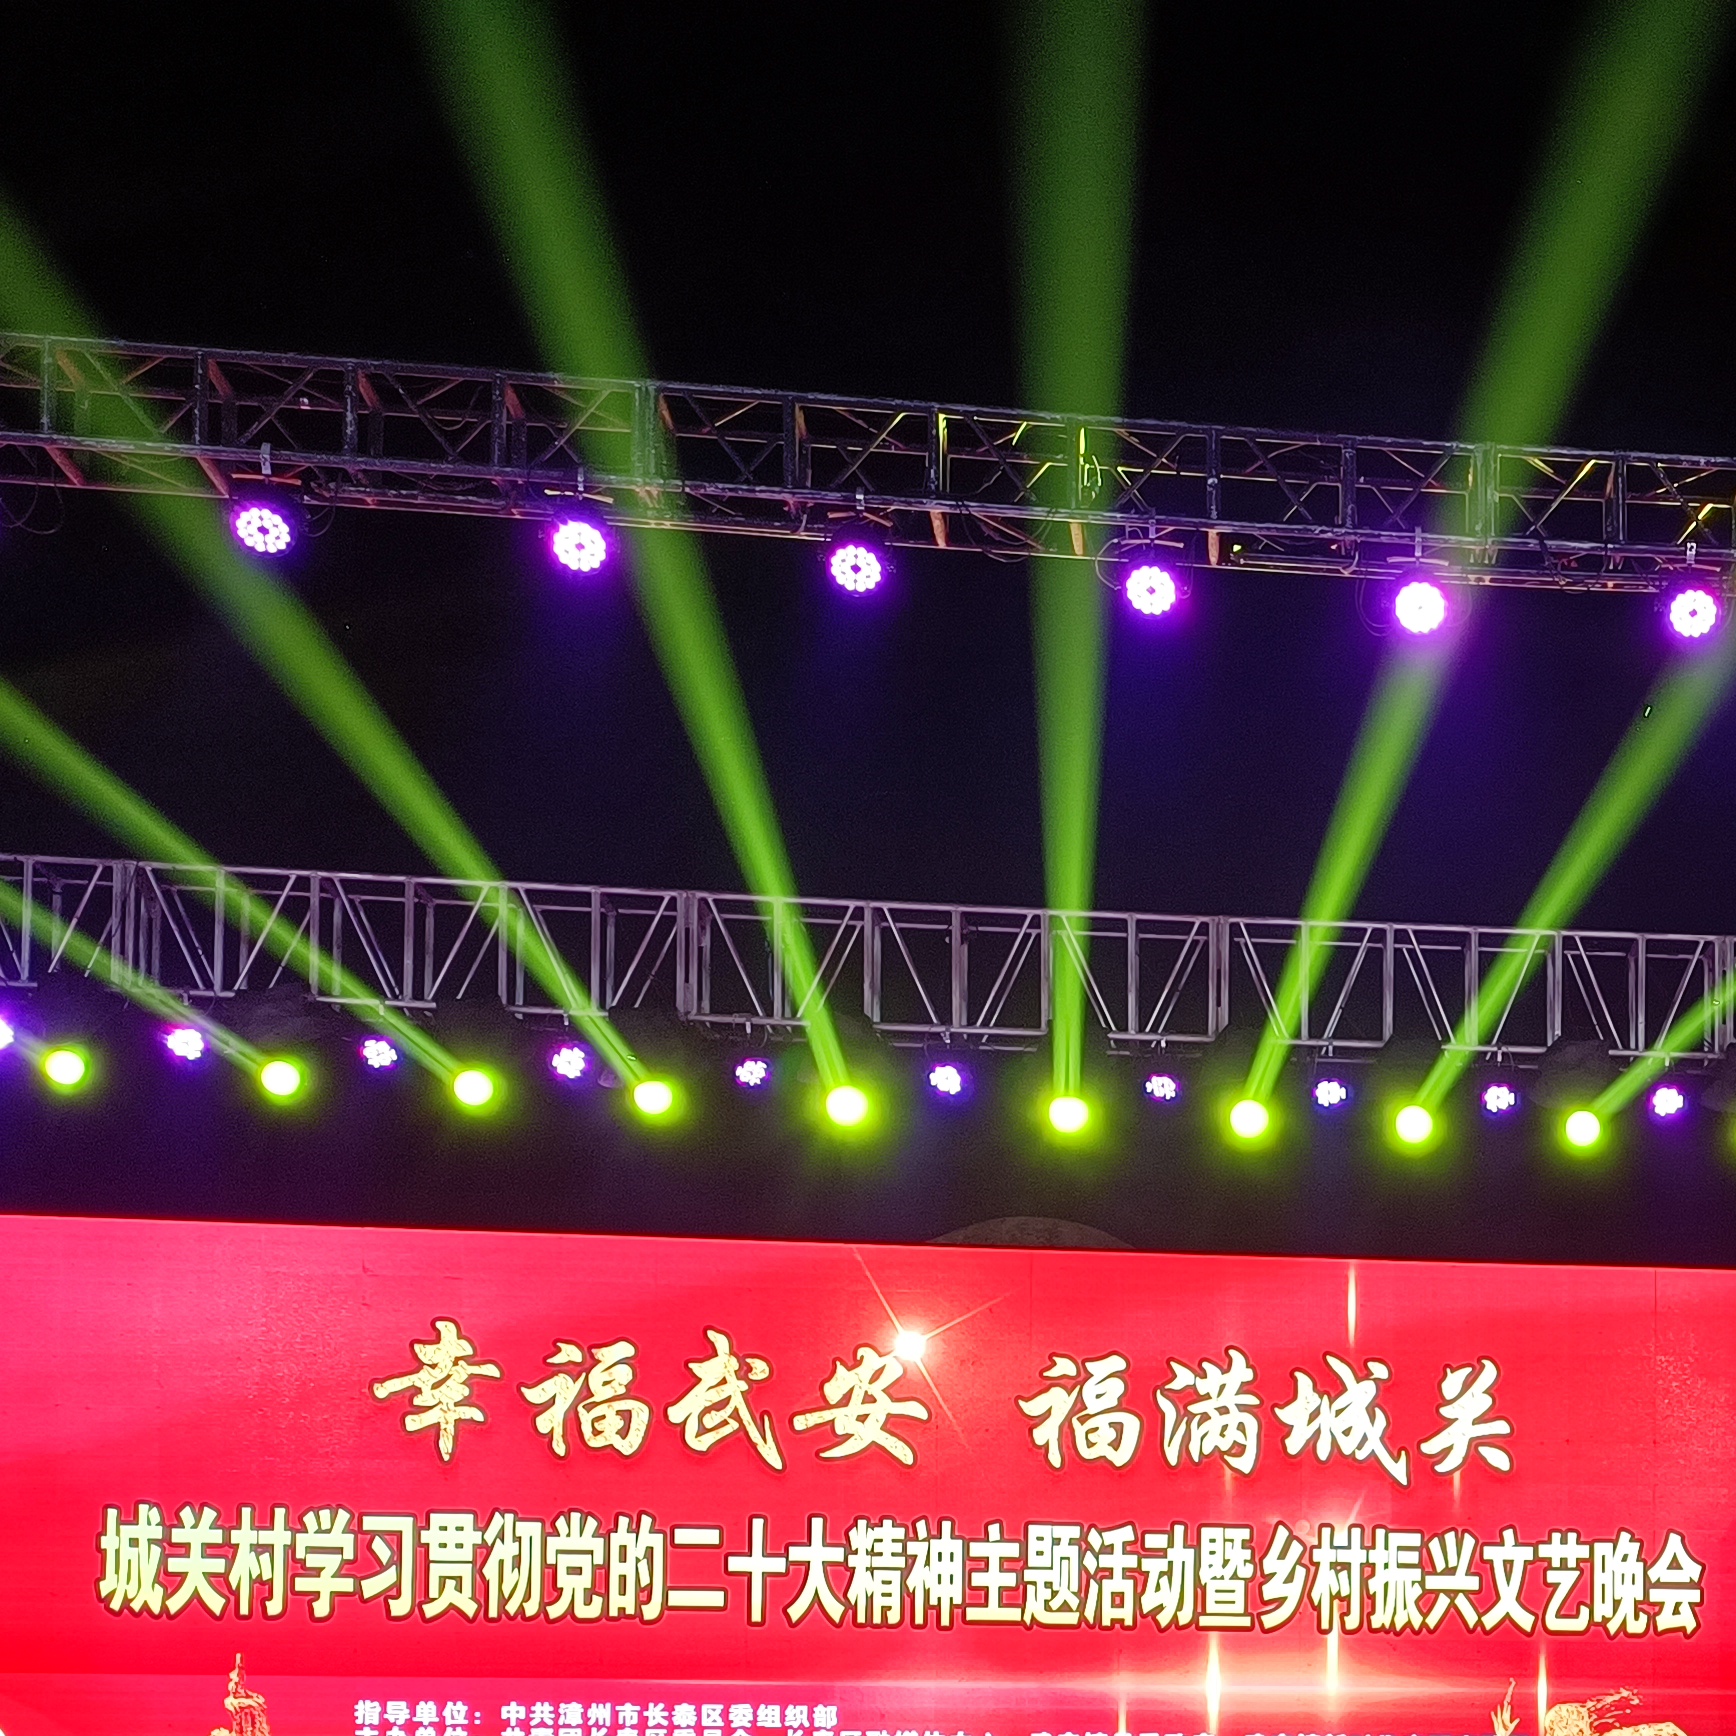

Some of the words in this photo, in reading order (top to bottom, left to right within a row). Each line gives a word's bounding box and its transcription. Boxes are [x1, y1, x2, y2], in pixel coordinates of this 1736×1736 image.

[372, 1319, 929, 1471] 幸福武安
[1019, 1347, 1516, 1485] 福满城关
[98, 1503, 1705, 1638] 城关村学习贯彻党的二十大精神主题活动暨乡村振兴文艺晚会
